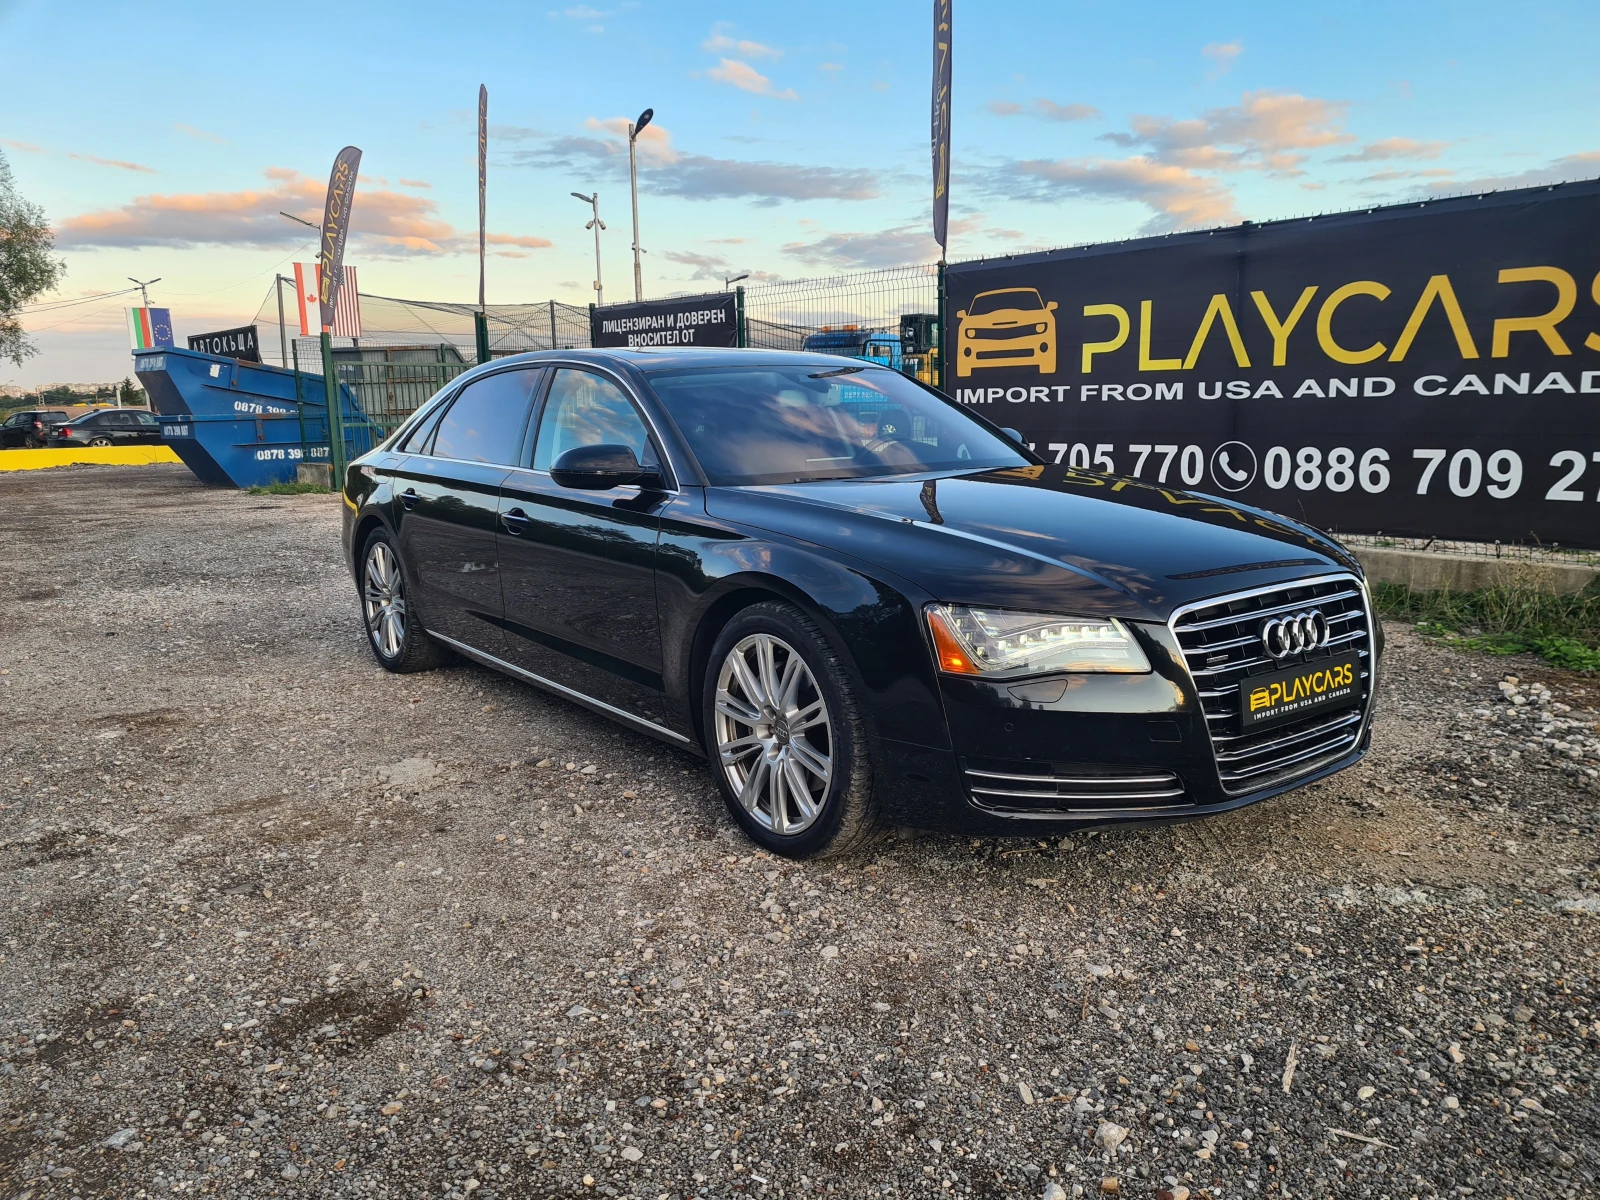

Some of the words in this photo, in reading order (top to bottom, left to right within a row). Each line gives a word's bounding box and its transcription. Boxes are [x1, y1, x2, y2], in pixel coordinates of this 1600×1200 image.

[322, 160, 349, 277] PLAYCARS
[602, 314, 665, 334] ЛИЦЕНЗИРАН
[667, 314, 674, 327] И
[676, 309, 726, 329] ДОВЕРЕН
[1081, 266, 1600, 374] PLAYCAR
[193, 332, 254, 354] АВТОКЪЩА
[628, 330, 679, 347] ВНОСИТЕЛ
[682, 329, 695, 343] ОТ
[956, 385, 1070, 404] IMPORT
[1080, 383, 1184, 401] FROM
[1198, 380, 1284, 399] USA
[1292, 377, 1396, 398] AND
[234, 400, 263, 414] 0878
[257, 449, 285, 460] 0878
[1128, 444, 1205, 486] 770
[1263, 446, 1391, 494] 0886
[1412, 448, 1523, 500] 709
[1545, 450, 1600, 502] 2
[1270, 663, 1353, 706] PLAYCARS
[1254, 708, 1279, 721] IMPORT
[1281, 703, 1298, 713] FROM
[1314, 695, 1326, 703] AND
[1329, 687, 1351, 699] CANADA
